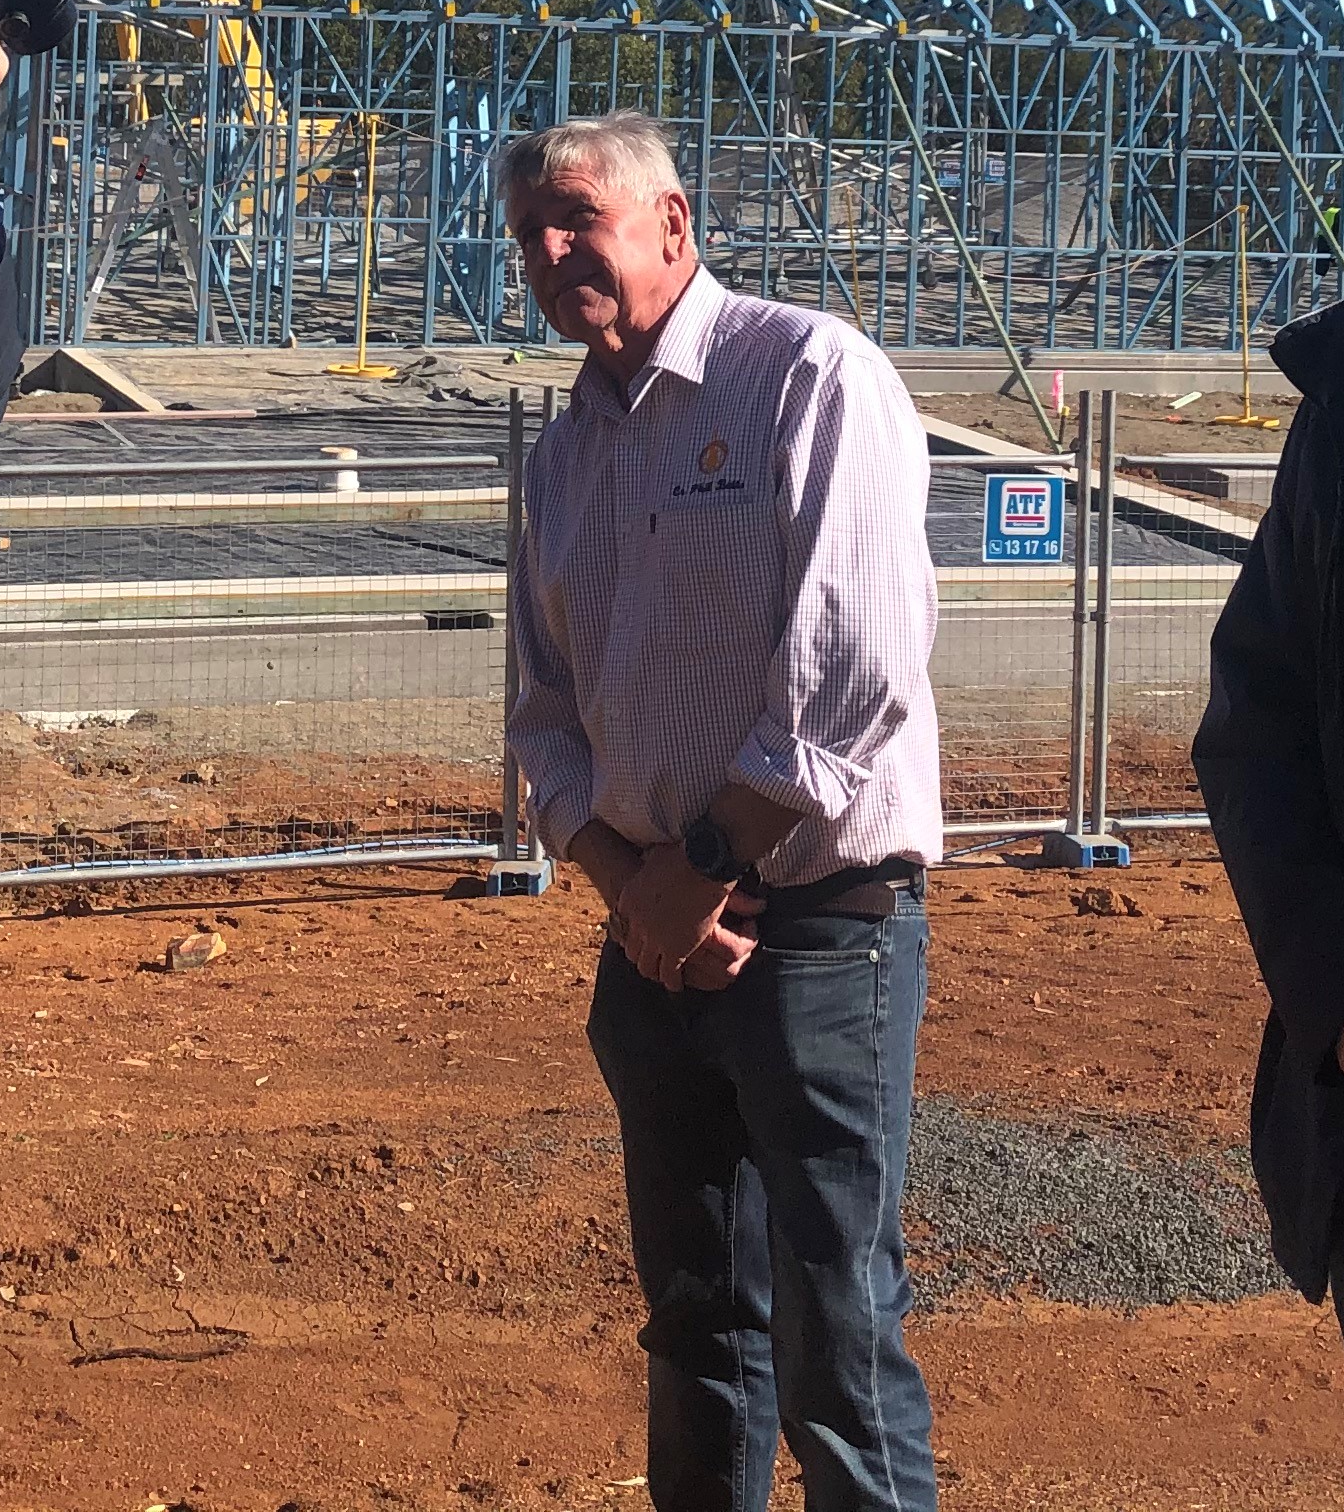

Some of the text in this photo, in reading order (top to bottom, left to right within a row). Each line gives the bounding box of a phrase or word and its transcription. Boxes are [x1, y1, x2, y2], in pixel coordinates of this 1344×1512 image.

[1006, 494, 1045, 514] ATF
[1004, 540, 1057, 555] 13 17 16
